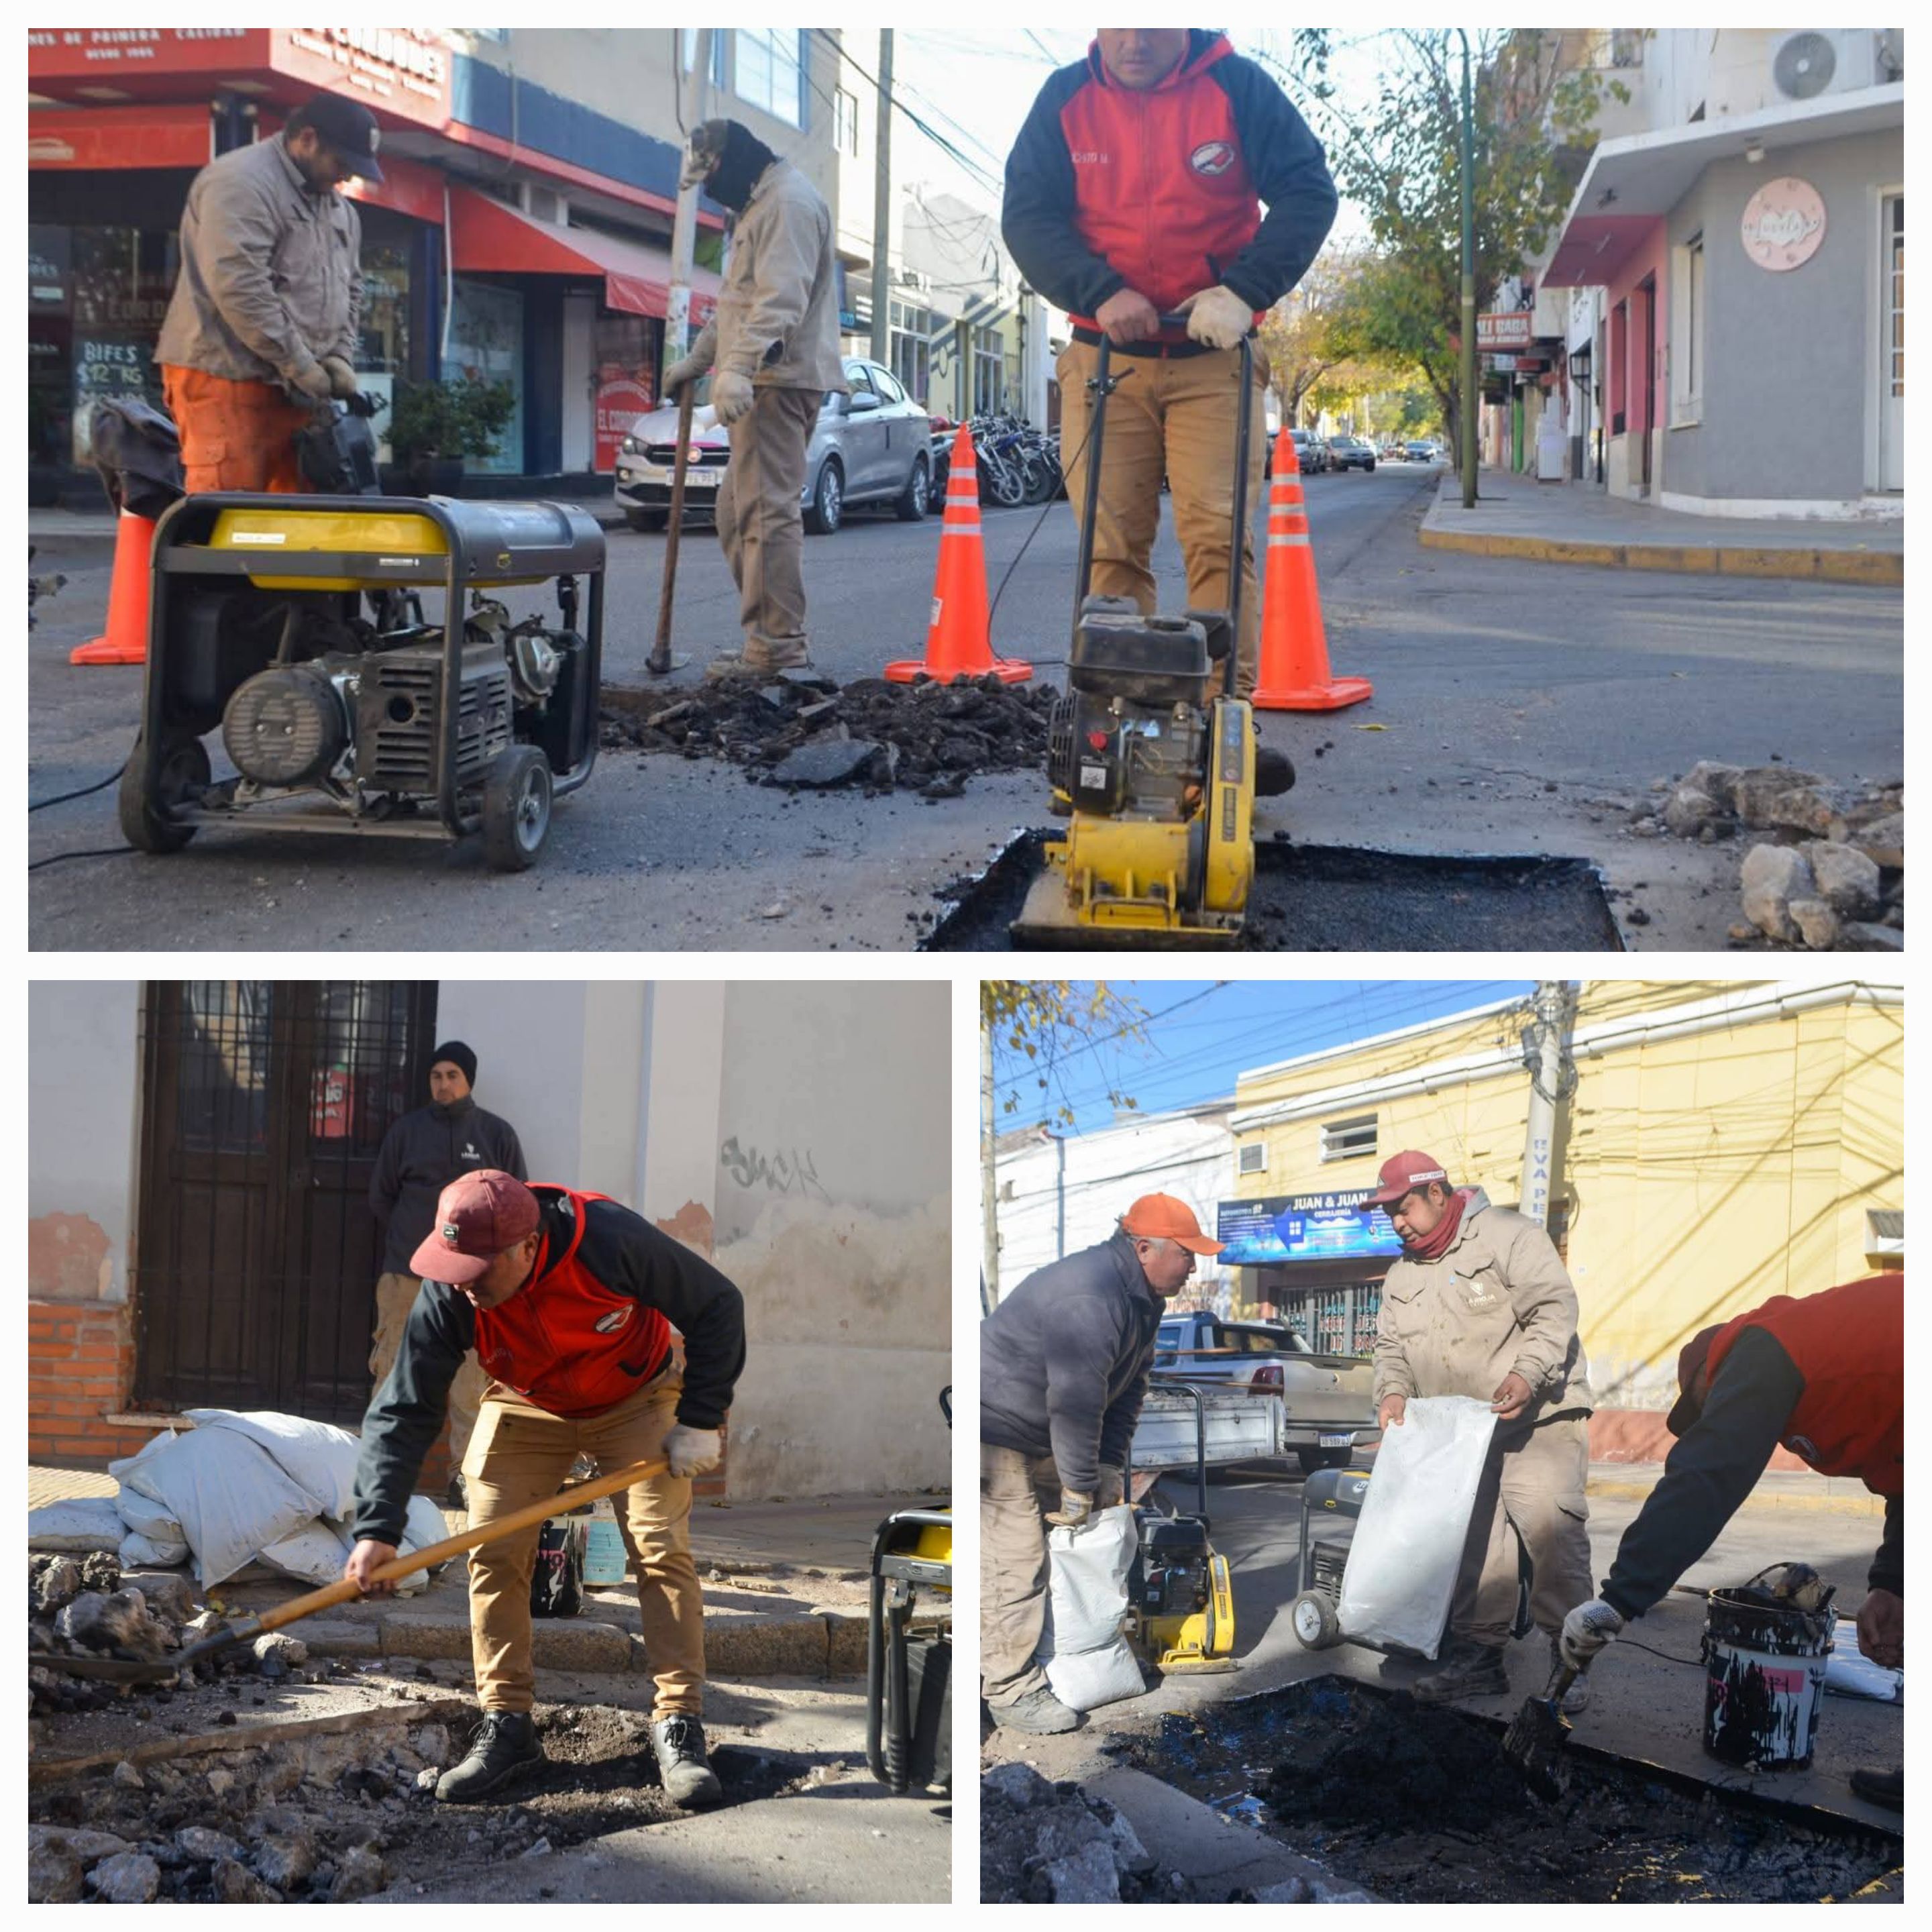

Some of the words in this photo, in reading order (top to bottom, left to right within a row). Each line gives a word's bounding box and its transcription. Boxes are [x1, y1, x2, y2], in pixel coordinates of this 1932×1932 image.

[84, 341, 138, 363] BIFES
[1293, 1197, 1320, 1211] JUAN
[1325, 1196, 1334, 1208] &
[1336, 1193, 1368, 1207] JUAN
